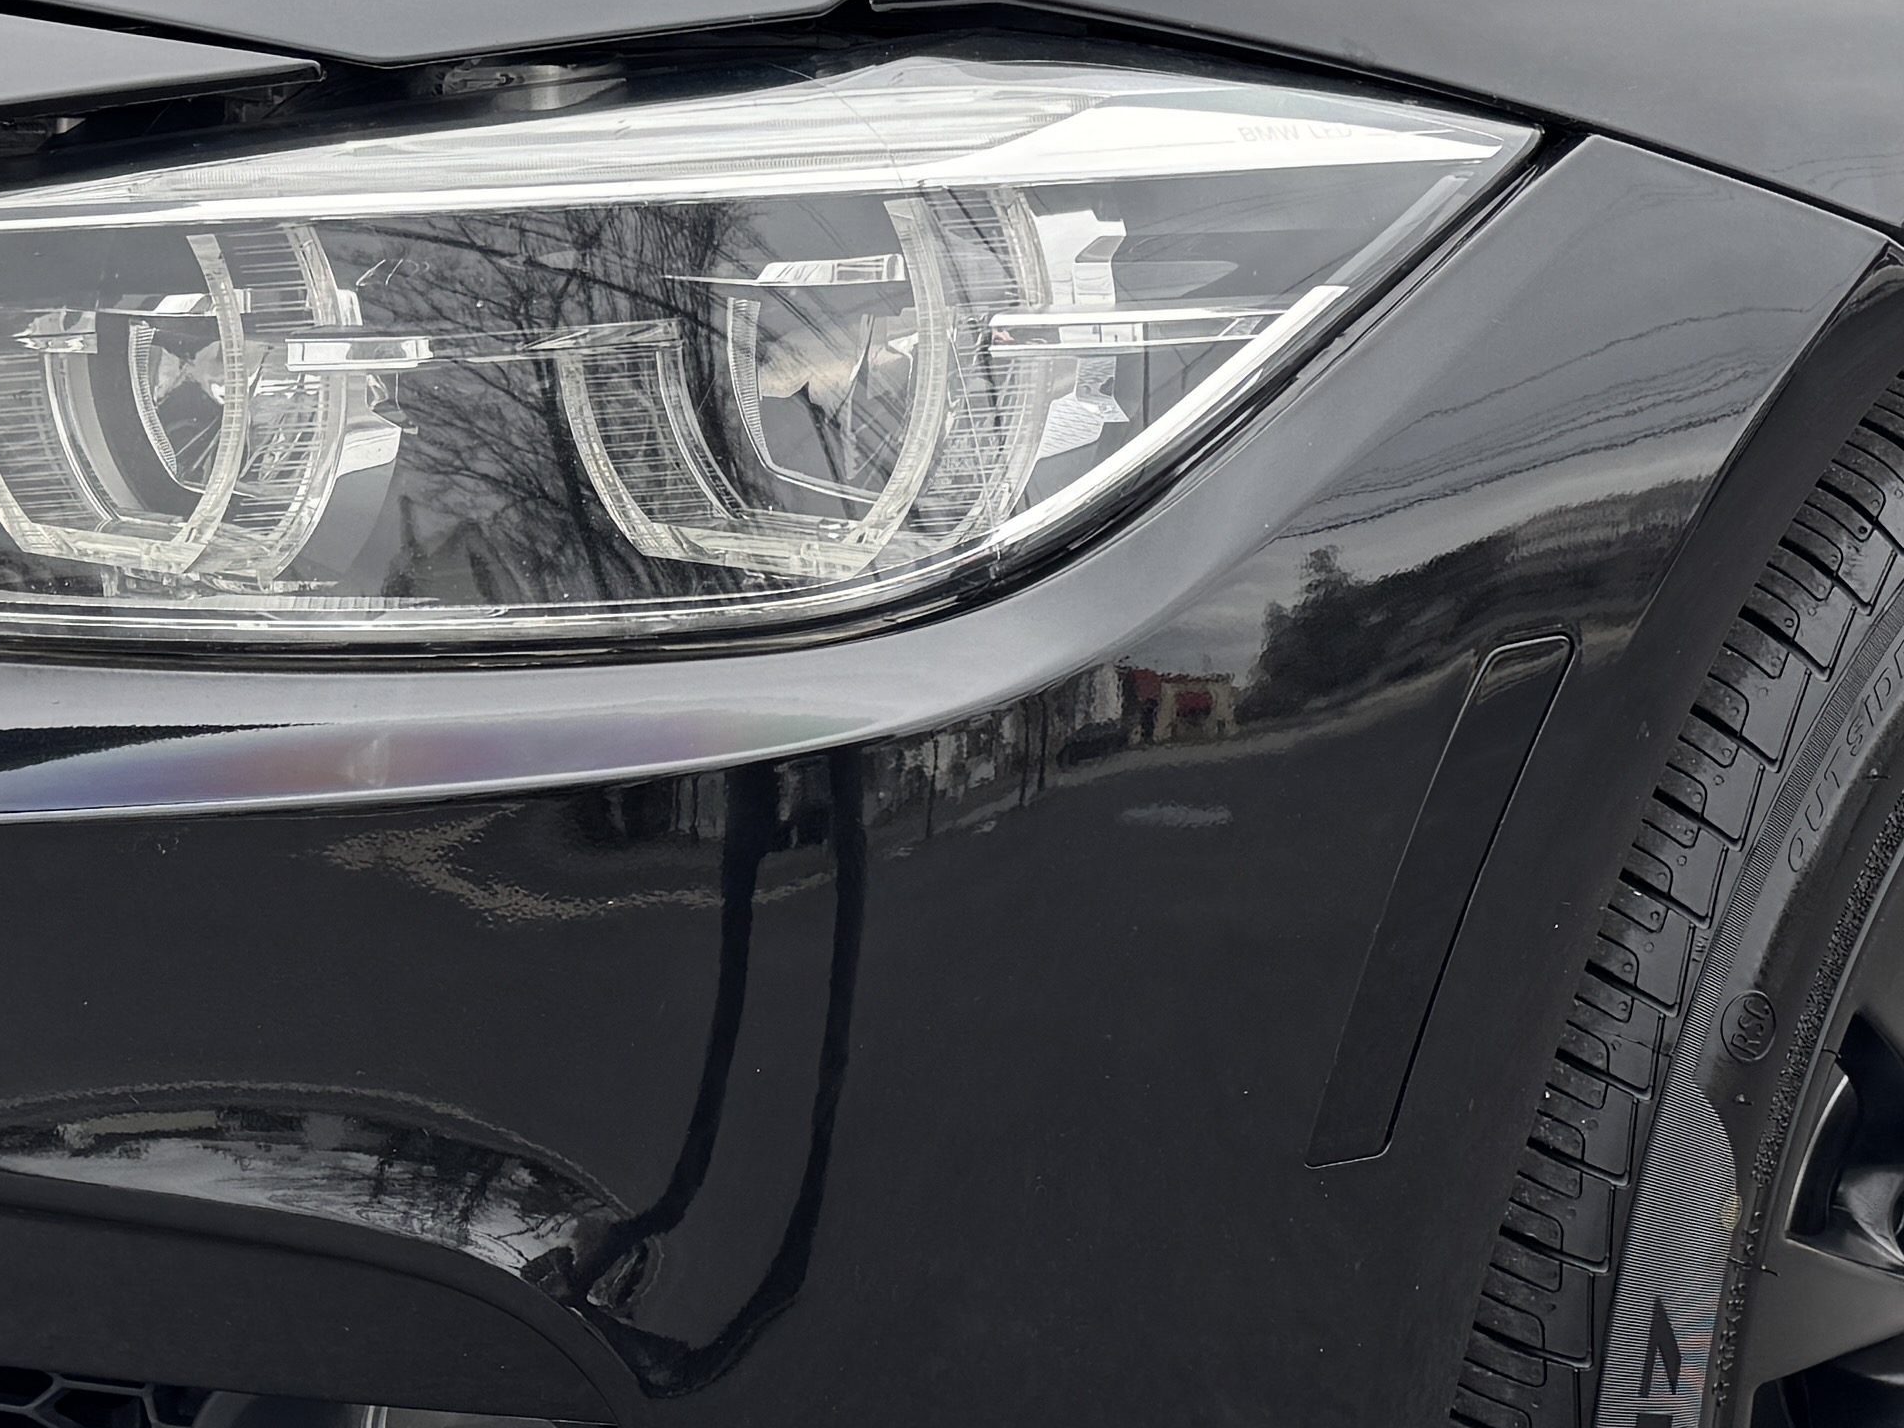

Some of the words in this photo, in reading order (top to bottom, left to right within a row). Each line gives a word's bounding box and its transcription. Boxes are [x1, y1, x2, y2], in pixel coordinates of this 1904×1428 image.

[1237, 124, 1301, 142] BMW
[1306, 123, 1353, 140] LED
[1730, 997, 1771, 1057] RSC
